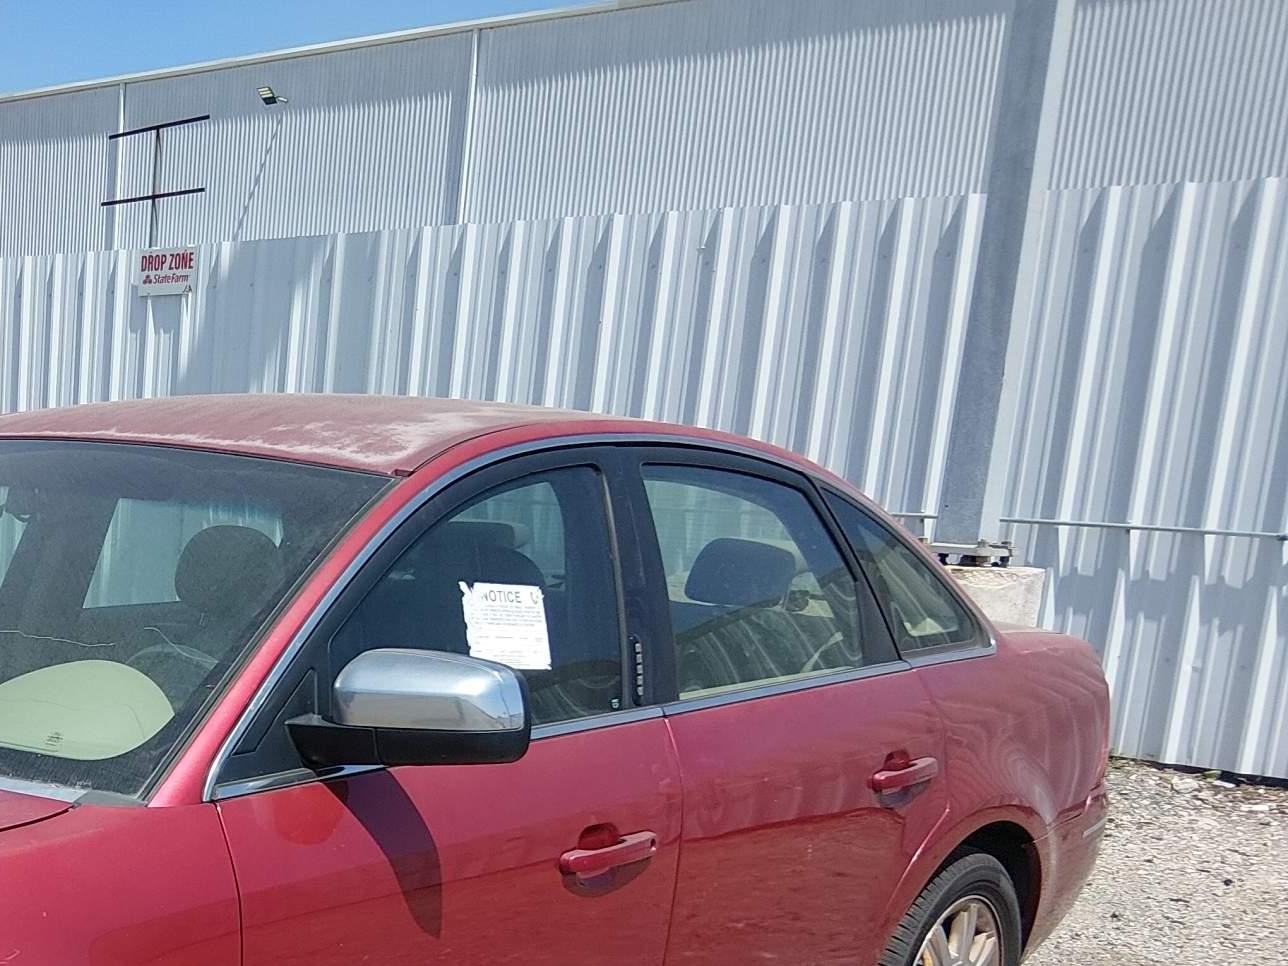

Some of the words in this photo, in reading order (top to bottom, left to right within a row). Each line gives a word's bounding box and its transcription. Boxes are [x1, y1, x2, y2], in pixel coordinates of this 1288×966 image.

[140, 254, 167, 273] DROP
[168, 251, 194, 270] ZONE
[481, 589, 522, 604] NOTICE
